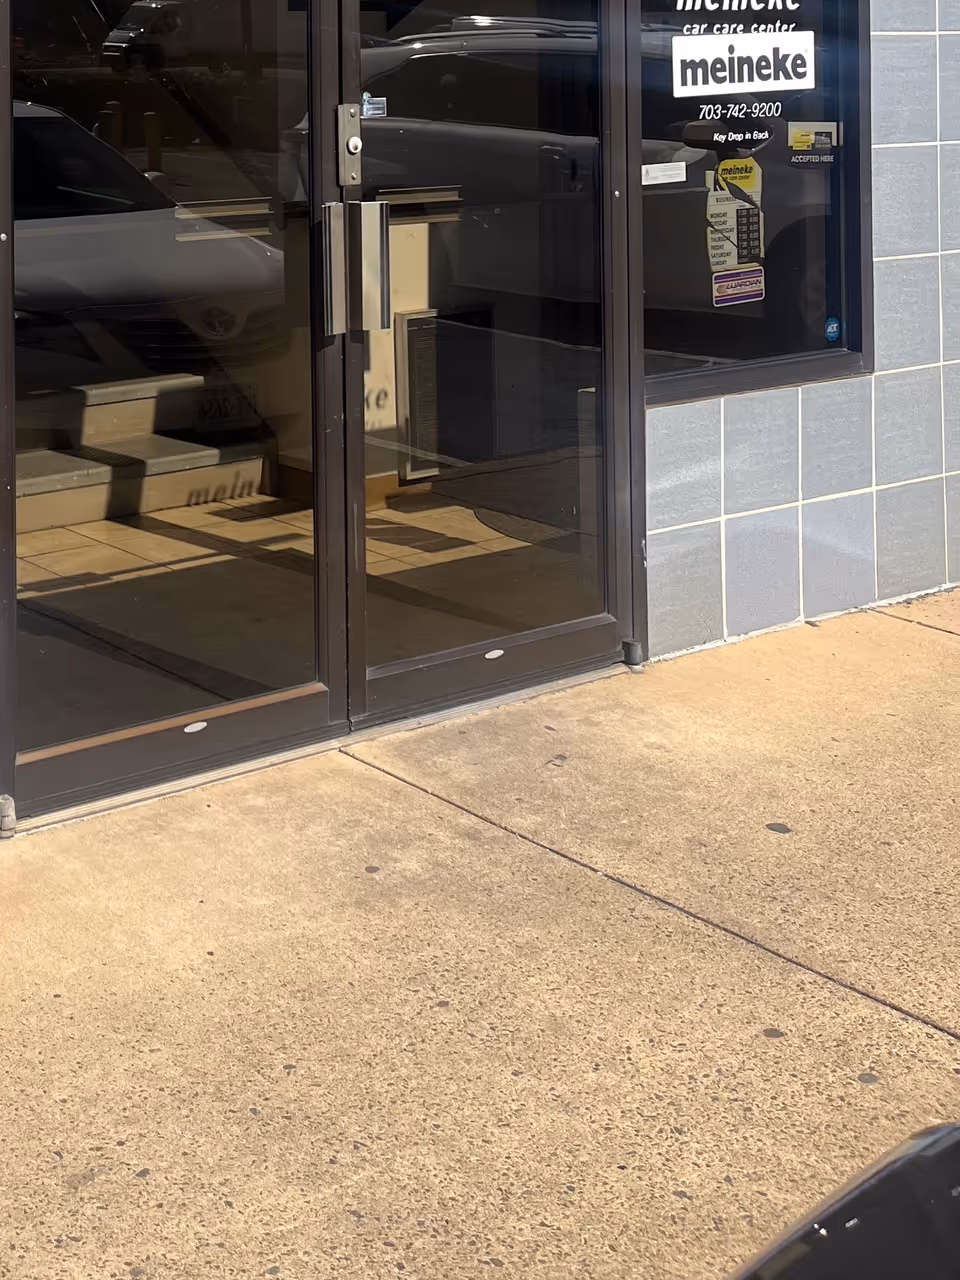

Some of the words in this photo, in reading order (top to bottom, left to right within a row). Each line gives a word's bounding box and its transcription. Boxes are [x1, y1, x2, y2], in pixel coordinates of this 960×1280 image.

[683, 23, 708, 35] car
[713, 23, 744, 35] care
[751, 20, 796, 33] center
[680, 44, 807, 87] meineke
[699, 102, 781, 120] 703-742-9200
[713, 132, 726, 143] Key
[728, 131, 743, 142] Drop
[745, 130, 751, 139] in
[791, 155, 819, 163] ACCEPTED
[721, 164, 753, 176] meineke
